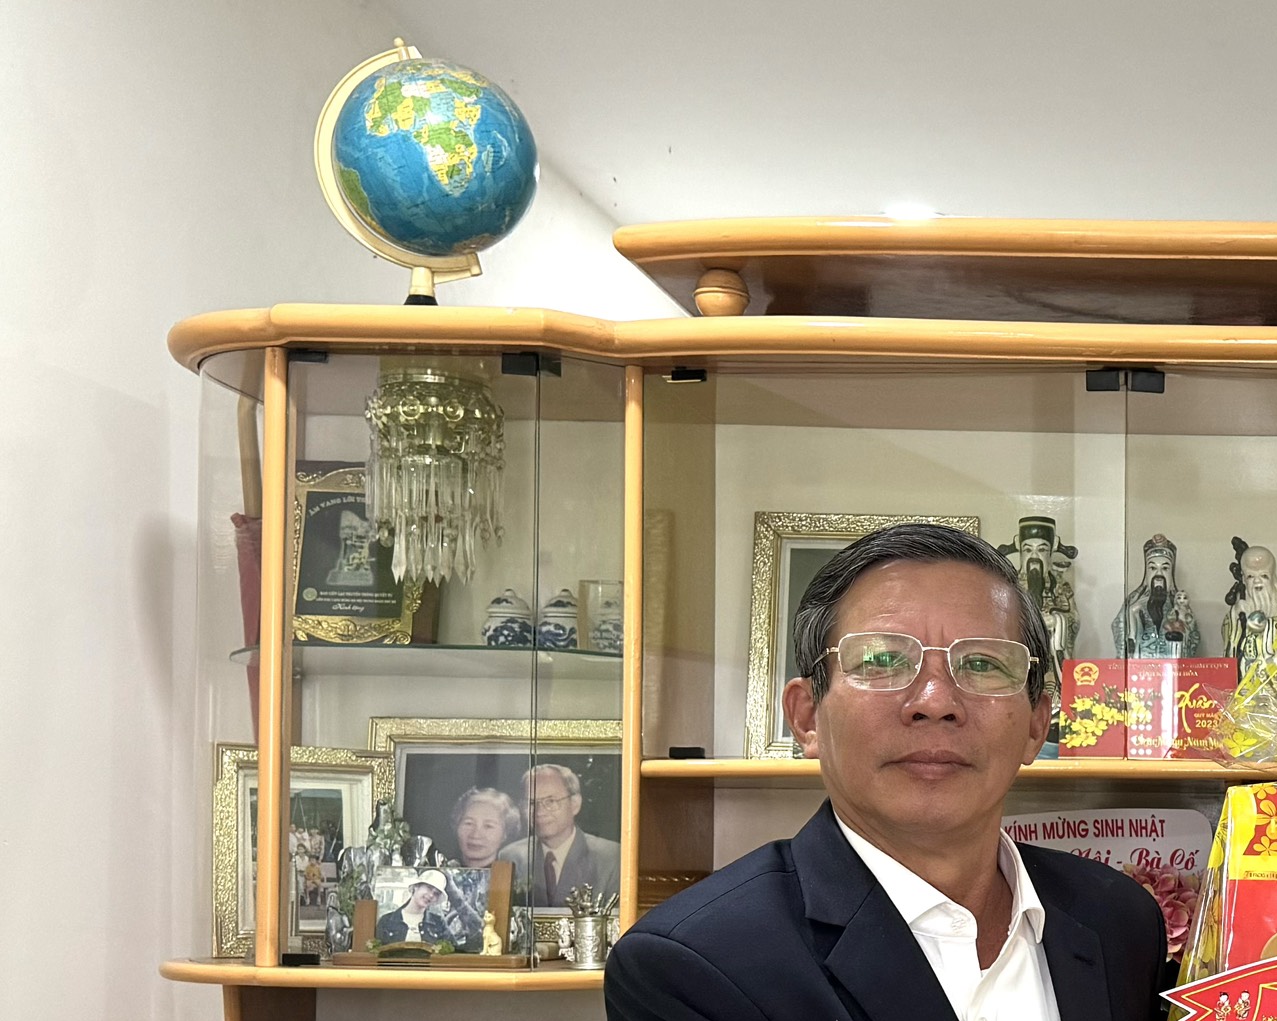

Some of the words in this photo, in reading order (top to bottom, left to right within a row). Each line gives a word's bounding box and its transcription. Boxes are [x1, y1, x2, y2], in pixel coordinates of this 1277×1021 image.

[1195, 720, 1219, 728] 2023
[1005, 820, 1038, 842] KÍNH
[1042, 816, 1089, 840] MỪNG
[1093, 819, 1124, 838] SINH
[1129, 814, 1166, 842] NHẬT
